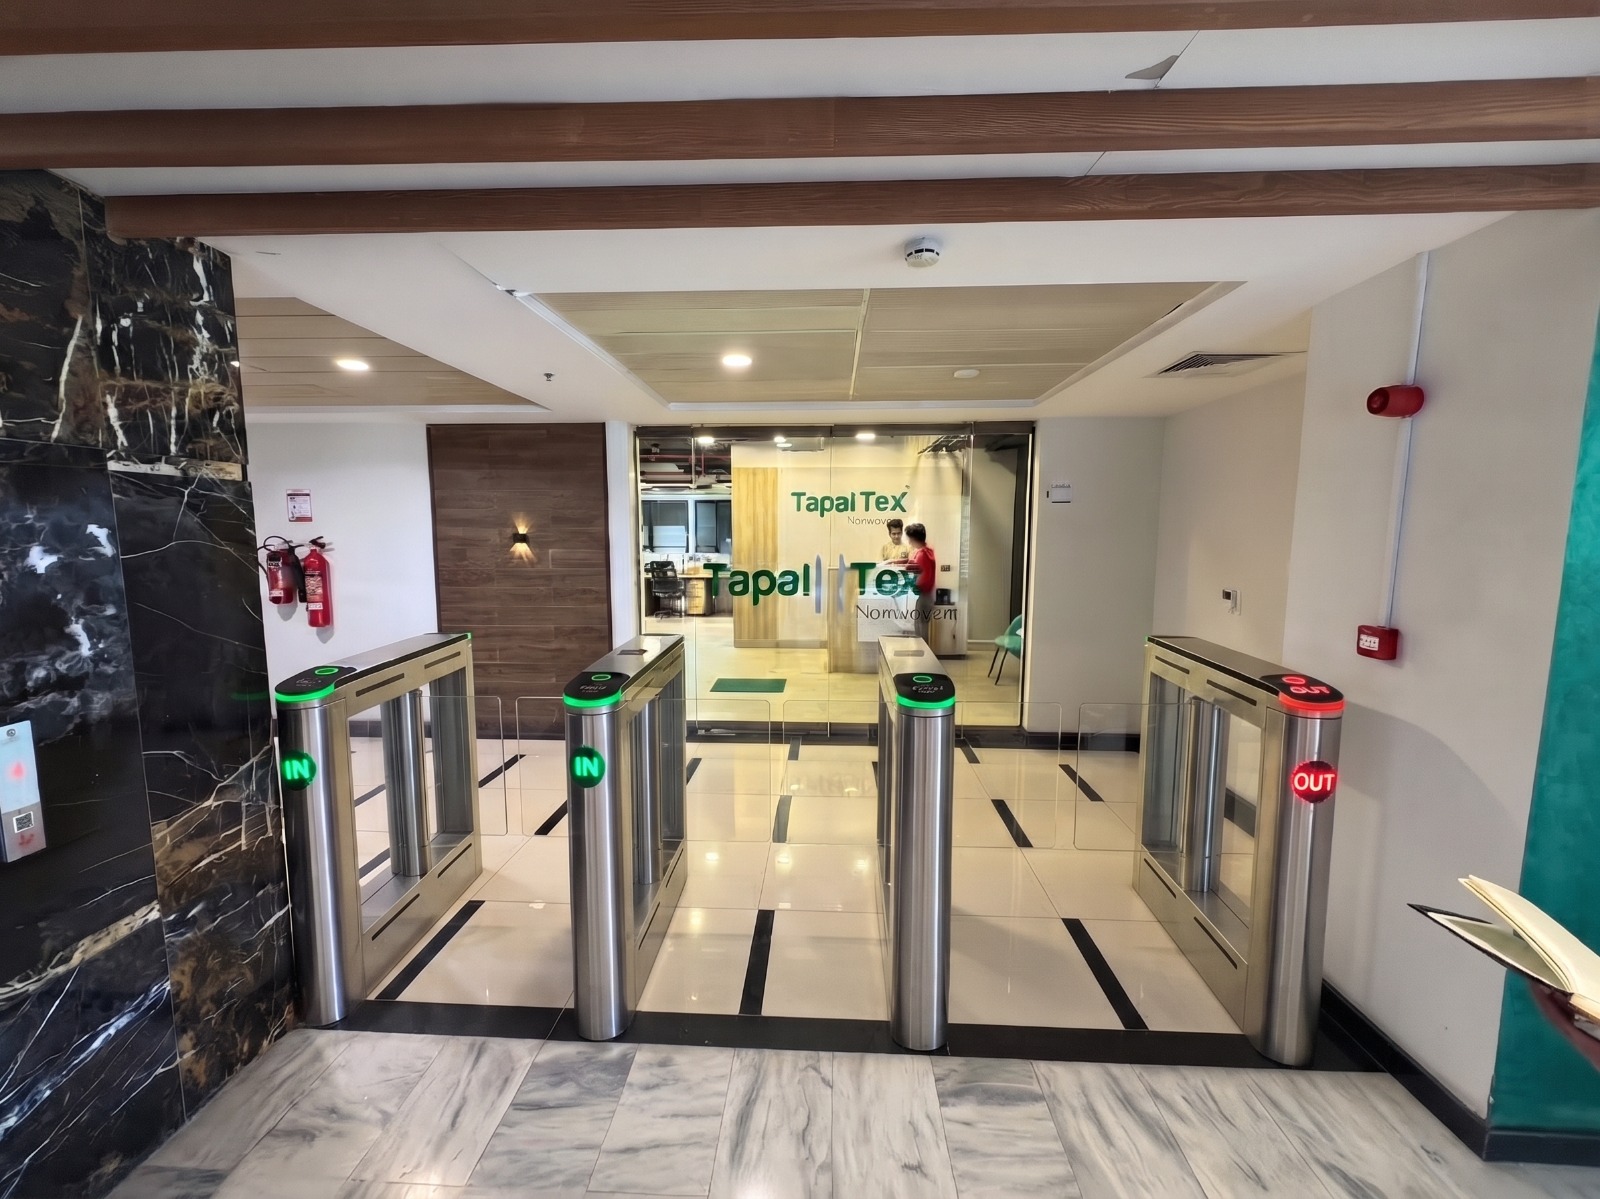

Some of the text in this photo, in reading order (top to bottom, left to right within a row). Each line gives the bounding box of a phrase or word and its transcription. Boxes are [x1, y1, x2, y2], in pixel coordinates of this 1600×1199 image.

[791, 491, 907, 517] Tapal Tex
[703, 562, 921, 606] Tapal Tex
[284, 760, 310, 779] IN
[574, 756, 599, 776] IN
[1293, 772, 1336, 792] OUT
